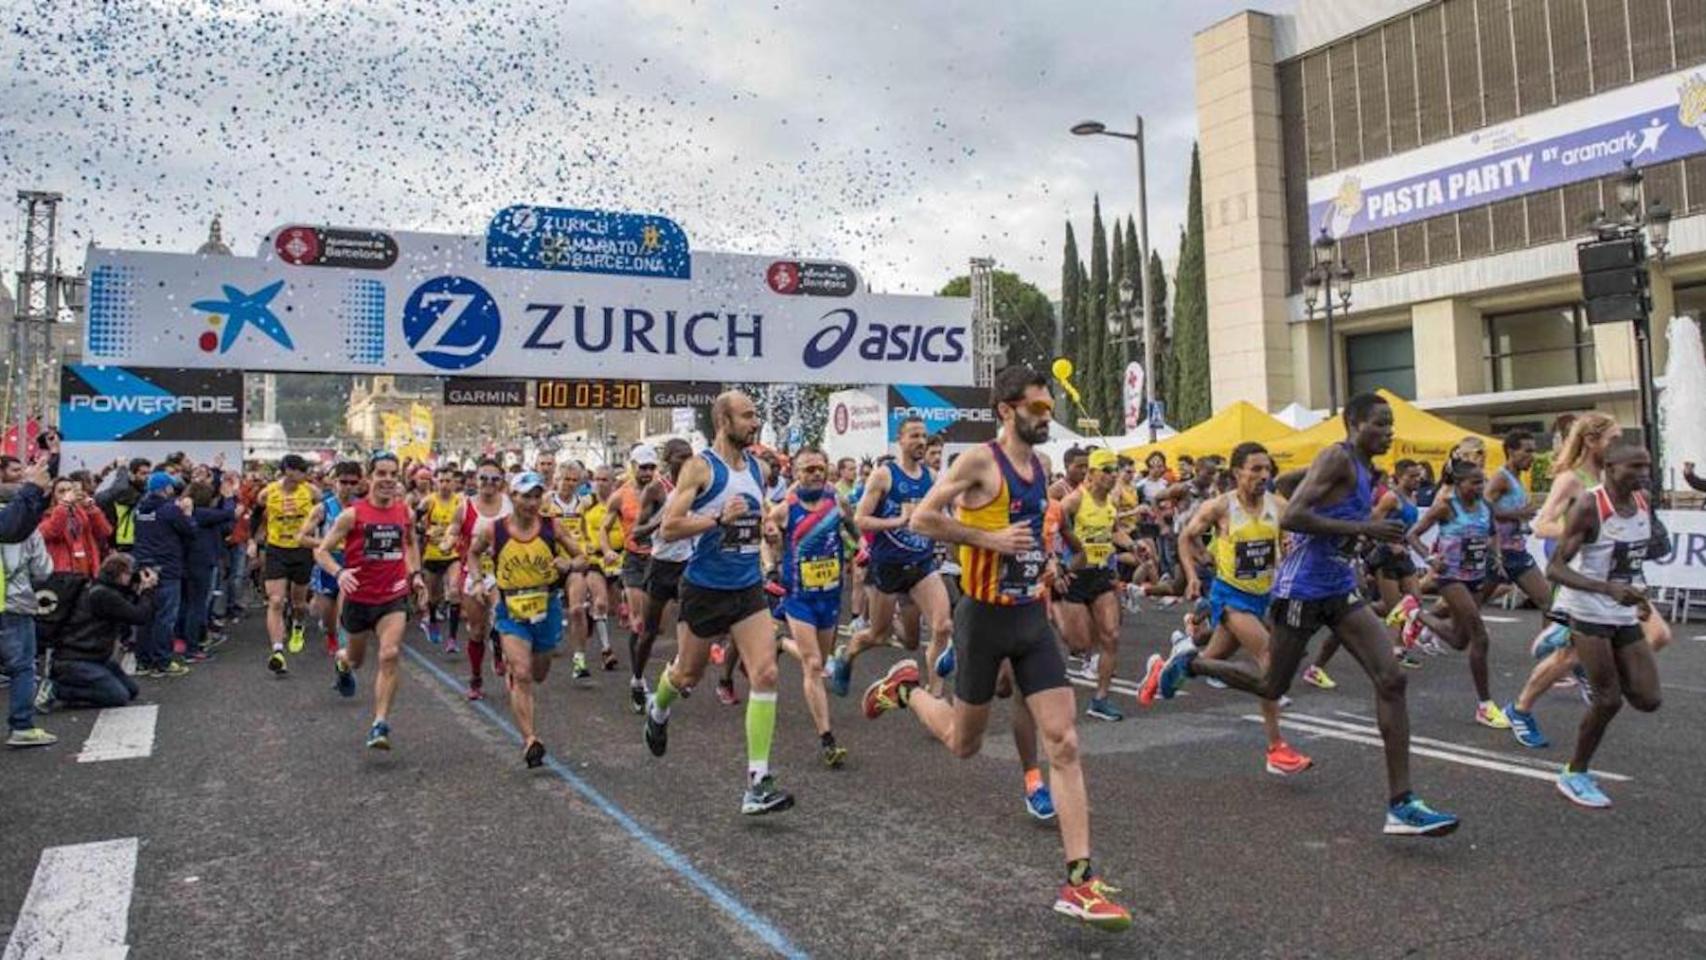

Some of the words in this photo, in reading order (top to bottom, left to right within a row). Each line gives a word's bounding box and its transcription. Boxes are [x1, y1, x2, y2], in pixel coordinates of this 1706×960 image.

[1367, 178, 1444, 220] PASTA
[1449, 153, 1533, 200] PARTY
[1541, 146, 1559, 162] BY
[1561, 131, 1637, 166] aramark
[542, 216, 609, 234] ZURICH
[325, 247, 385, 260] Barcelona
[571, 253, 666, 272] BARCELONA
[521, 303, 763, 357] ZURICH
[859, 323, 966, 362] asics
[69, 393, 238, 414] POWERADE
[450, 388, 519, 403] GARMIN
[539, 382, 567, 407] 00
[575, 384, 640, 408] 03:30
[654, 390, 716, 405] GARMIN
[893, 406, 992, 421] POWERADE
[1023, 563, 1038, 577] 29
